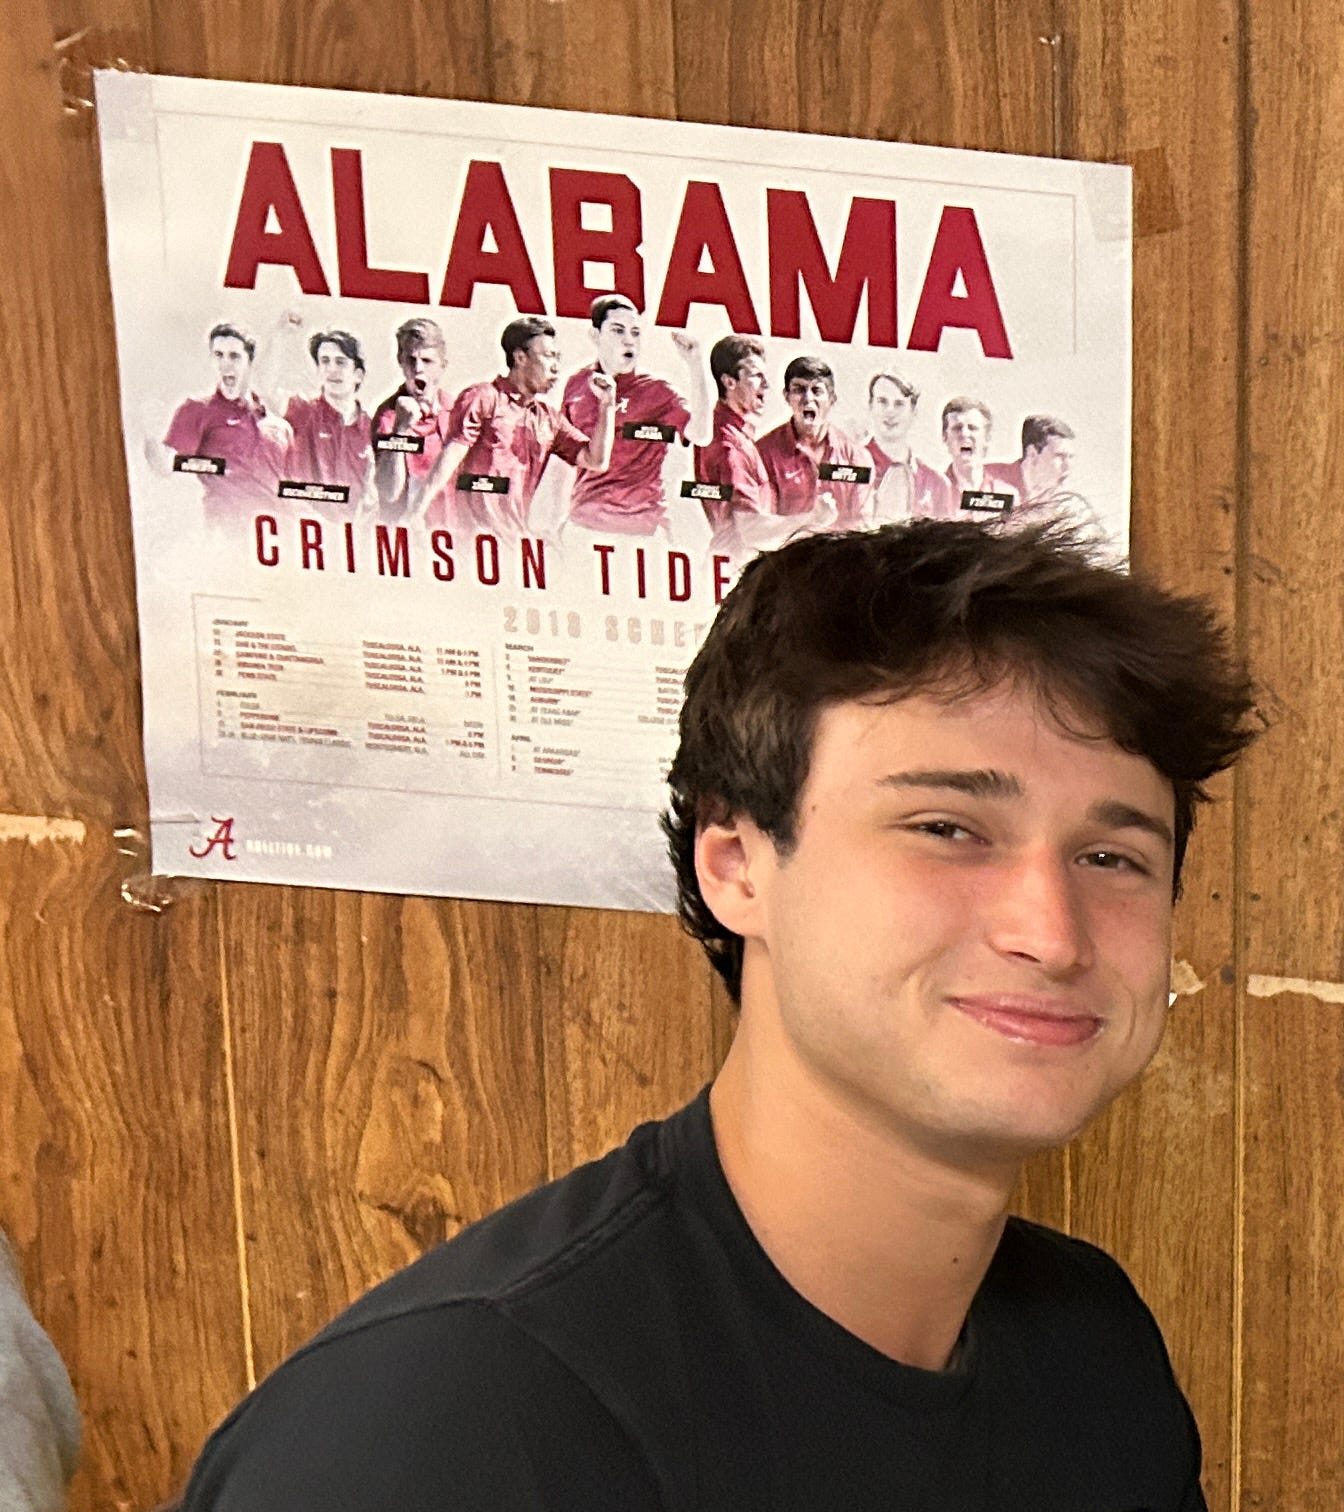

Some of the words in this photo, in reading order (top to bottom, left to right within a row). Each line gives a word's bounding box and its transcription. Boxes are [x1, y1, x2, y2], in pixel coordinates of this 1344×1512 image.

[223, 140, 1014, 360] ALABAMA
[255, 514, 546, 590] CRIMSON
[593, 544, 732, 606] TIDE
[503, 605, 581, 638] 2018
